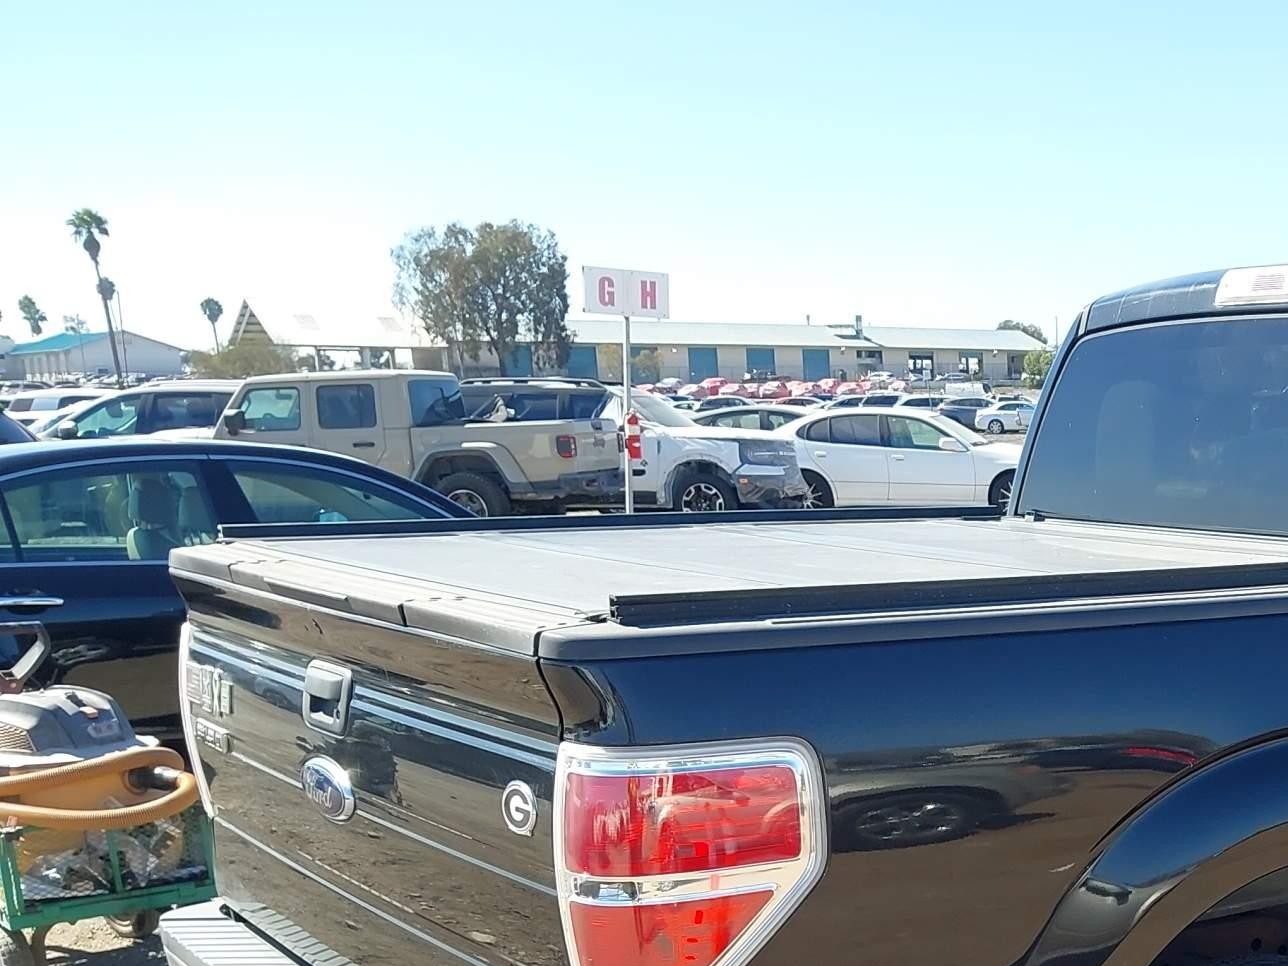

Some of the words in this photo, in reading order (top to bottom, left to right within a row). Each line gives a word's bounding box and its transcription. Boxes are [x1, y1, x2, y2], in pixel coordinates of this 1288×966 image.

[598, 276, 615, 307] G
[640, 280, 657, 310] H
[504, 788, 531, 829] G
